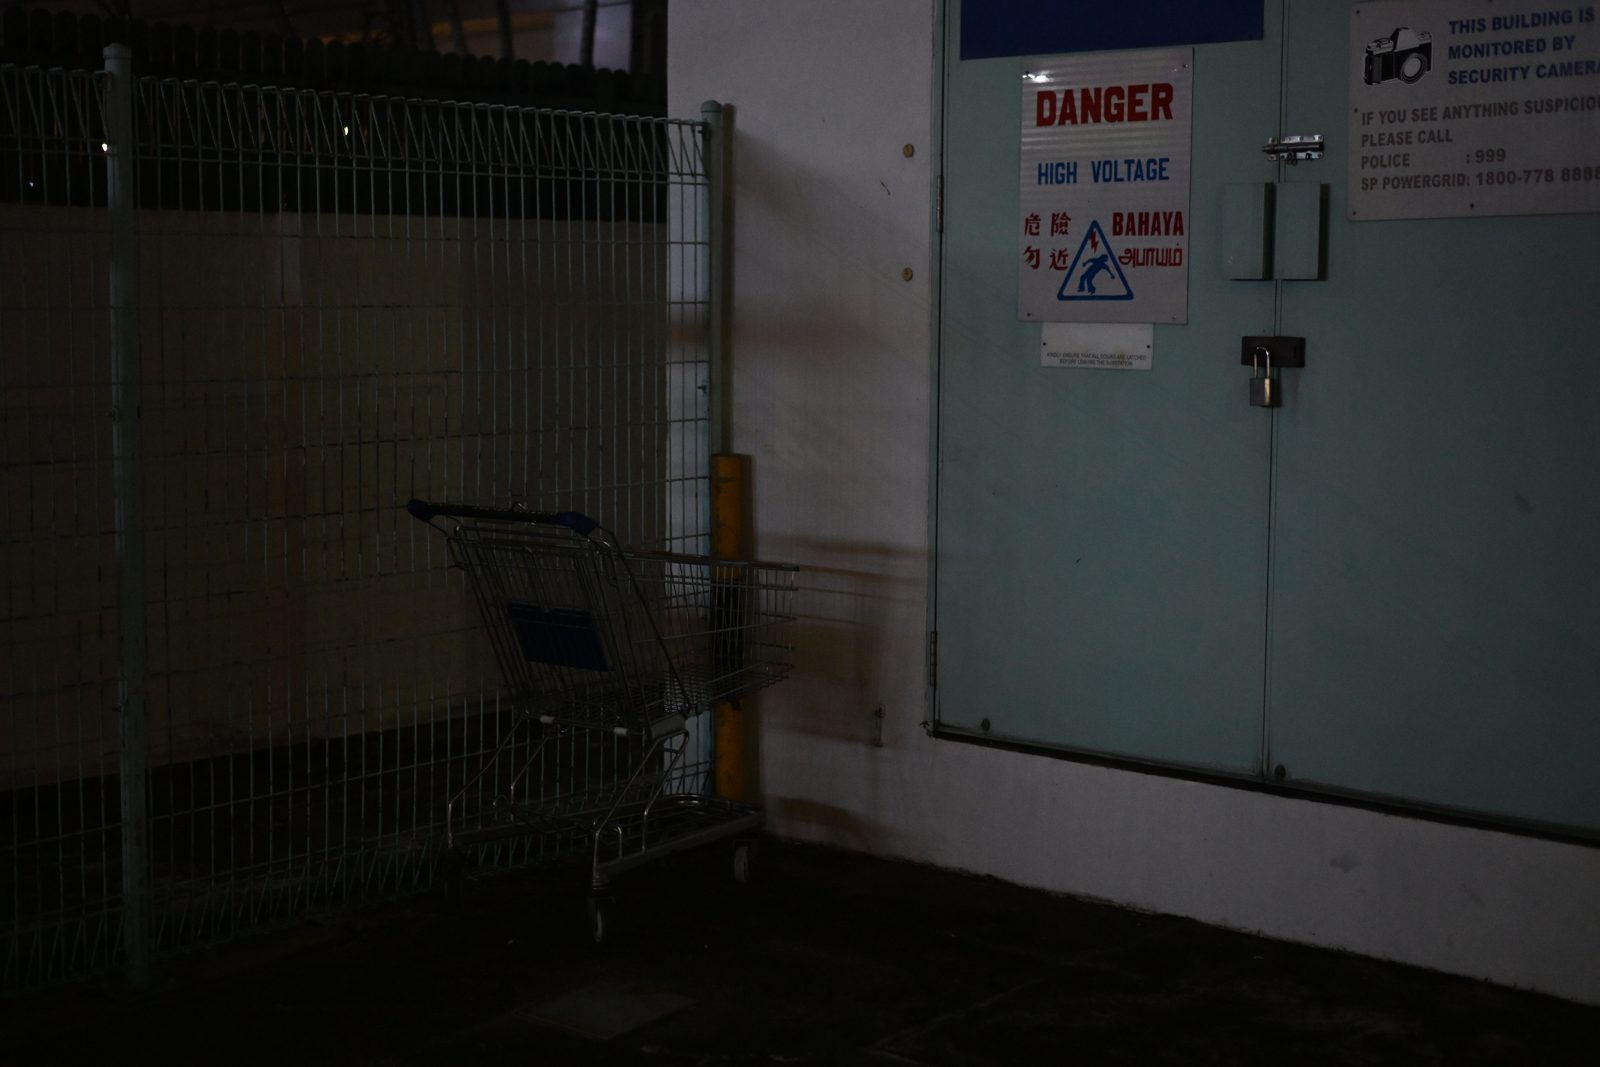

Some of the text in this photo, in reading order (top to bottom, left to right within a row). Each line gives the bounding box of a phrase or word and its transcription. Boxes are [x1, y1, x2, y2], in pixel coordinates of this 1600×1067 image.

[1449, 7, 1595, 35] THIS BUILDING IS
[1448, 35, 1576, 60] MONITORED BY
[1447, 65, 1531, 85] SECURITY
[1036, 83, 1174, 127] DANGER
[1361, 96, 1600, 126] IF YOU SEE ANYTHING SUSPICIO
[1361, 128, 1453, 148] PLEASE CALL
[1038, 157, 1170, 185] HIGH VOLTAGE
[1361, 153, 1411, 169] POLICE
[1475, 148, 1507, 164] 999
[1361, 176, 1378, 191] SP
[1476, 169, 1554, 186] 1800-778
[1112, 211, 1184, 237] BAHAYA
[1118, 242, 1183, 268] அபாயம்
